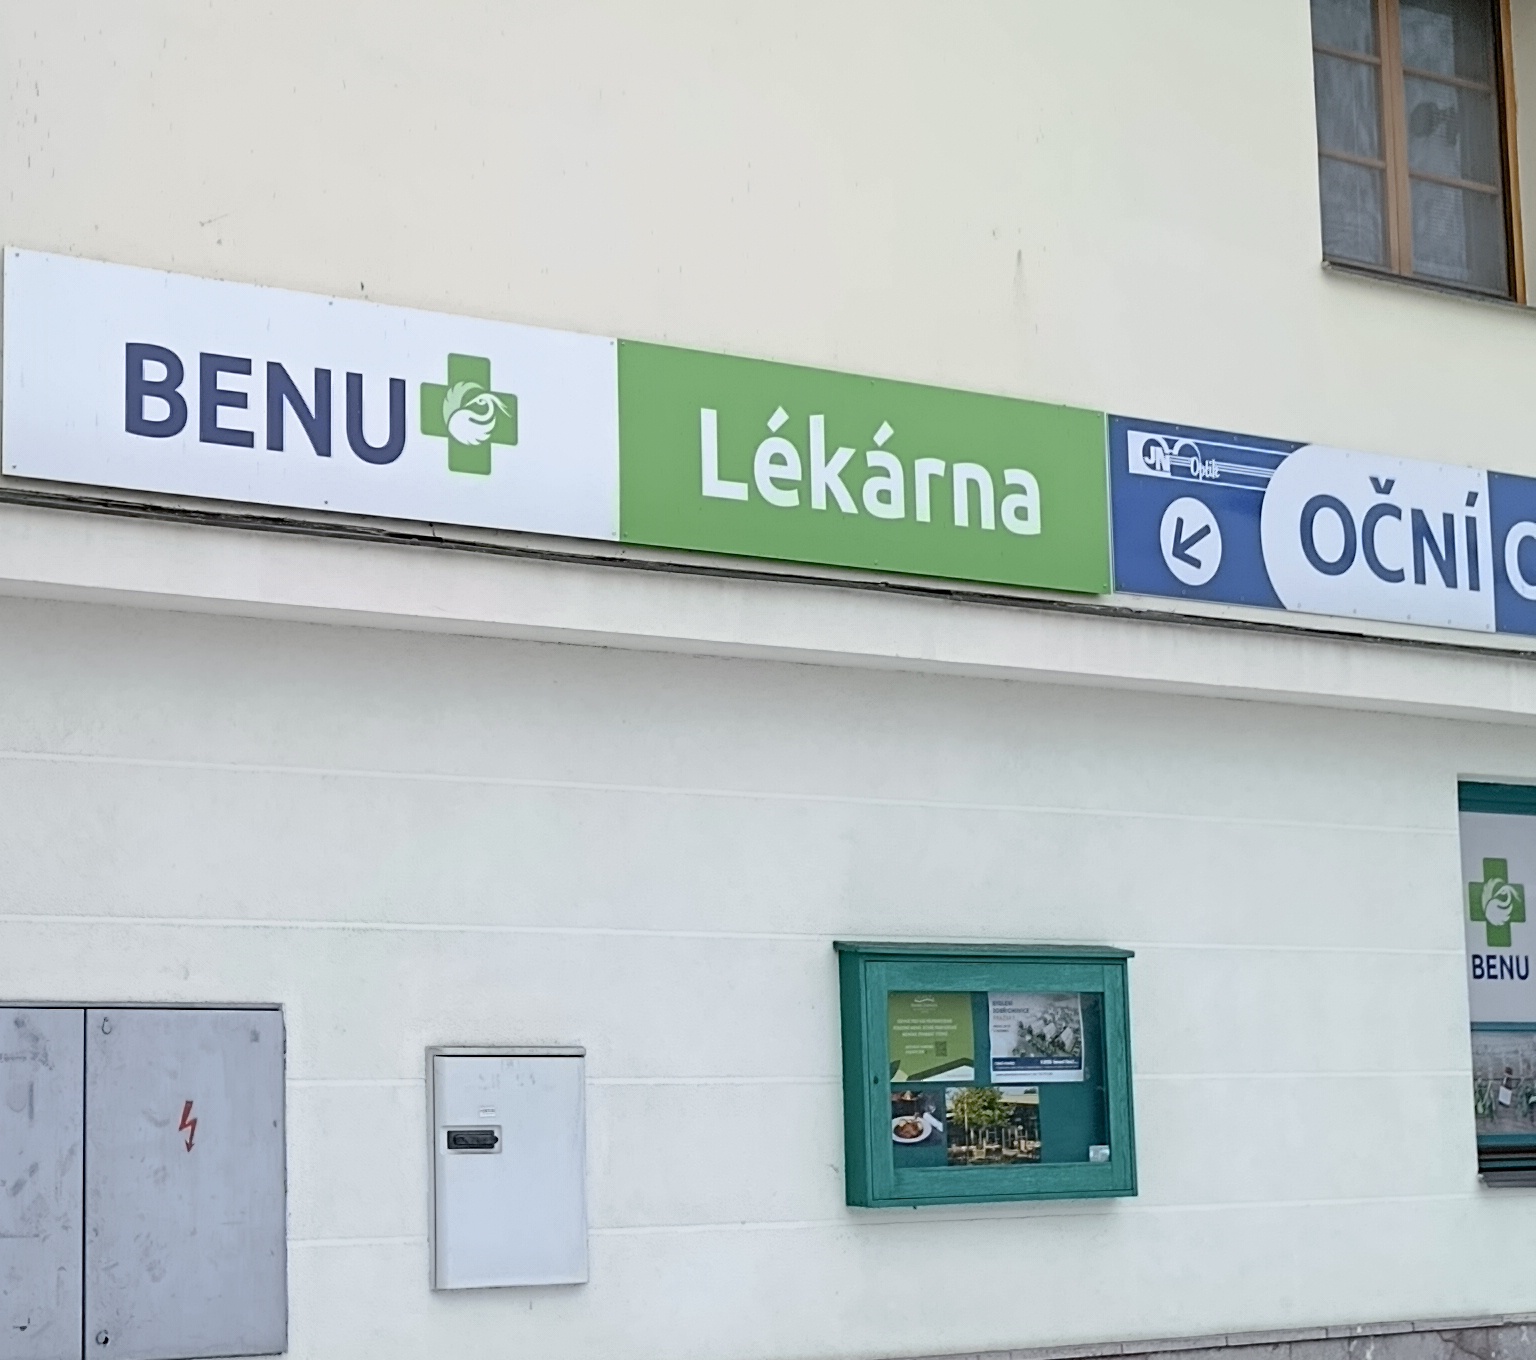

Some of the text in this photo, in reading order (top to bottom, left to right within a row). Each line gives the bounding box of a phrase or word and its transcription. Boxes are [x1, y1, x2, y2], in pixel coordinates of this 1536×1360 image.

[124, 342, 406, 465] BENU
[699, 406, 1043, 536] Lékárna
[1298, 477, 1482, 593] OČNÍ
[1471, 954, 1529, 981] BENU
